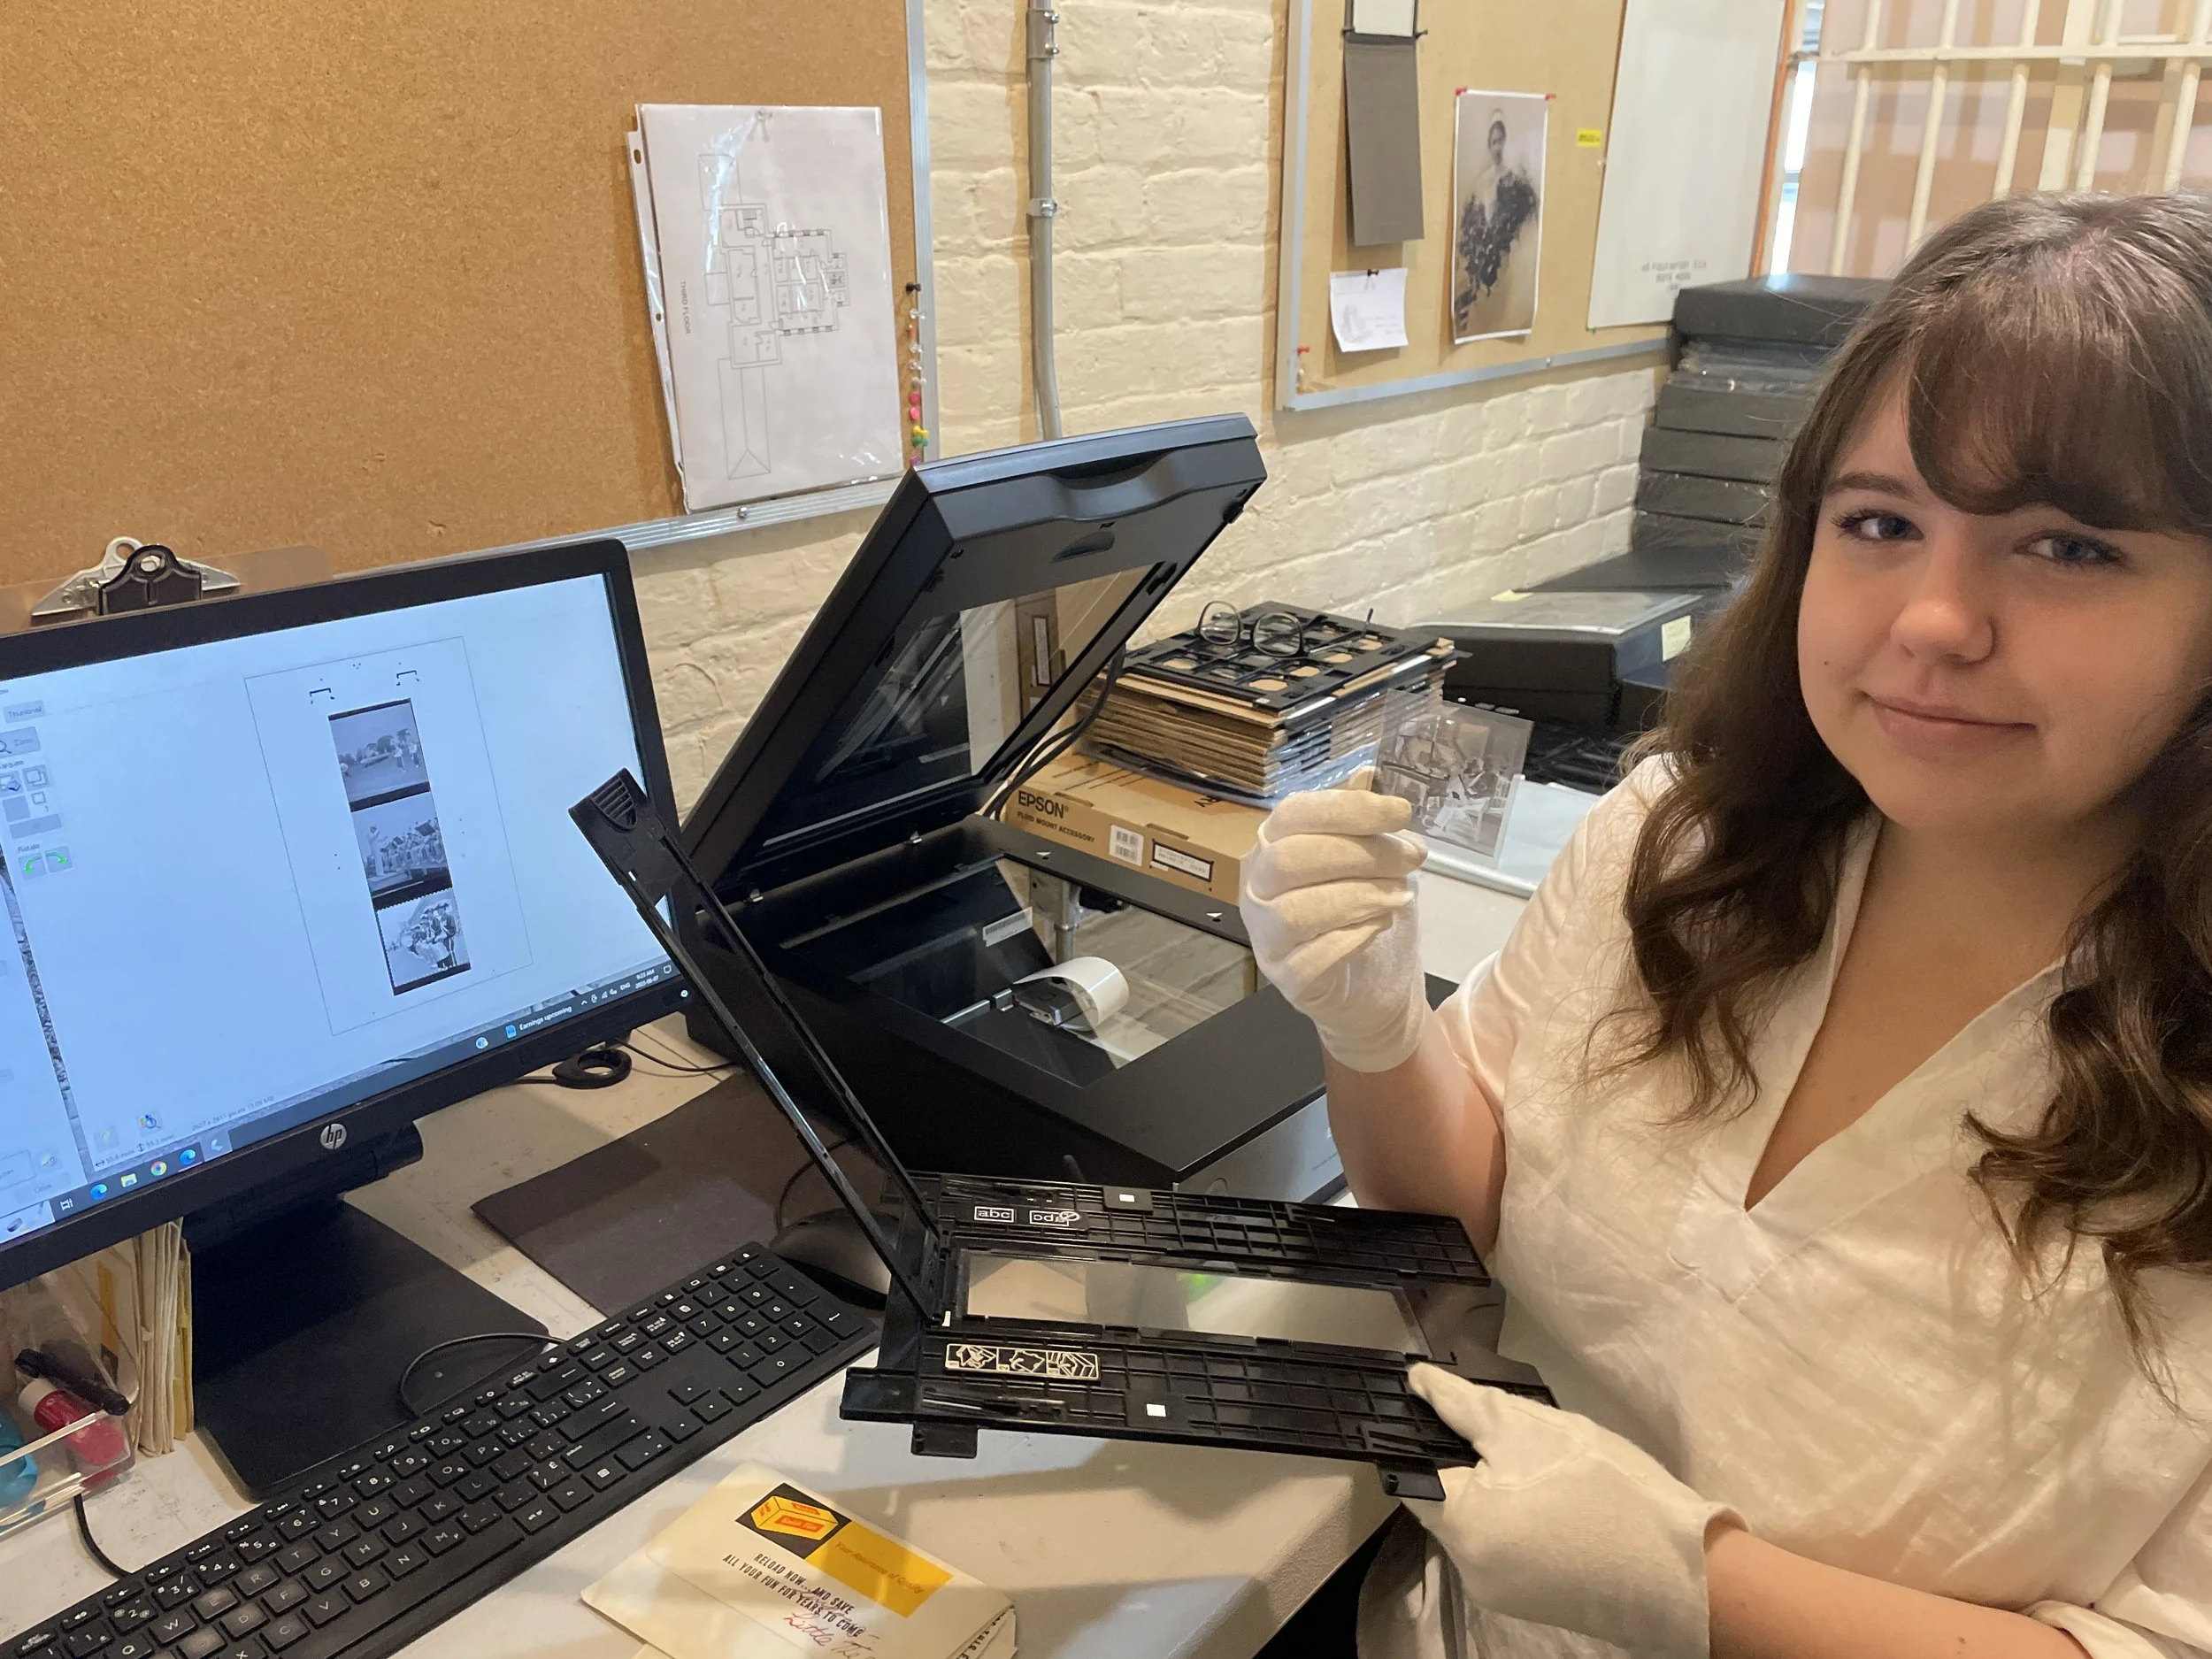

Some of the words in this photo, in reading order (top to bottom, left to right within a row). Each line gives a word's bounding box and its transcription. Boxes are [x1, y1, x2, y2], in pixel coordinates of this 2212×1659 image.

[680, 280, 688, 305] THIRD
[682, 307, 691, 334] FLOOR
[1036, 818, 1057, 831] MOUNT
[1059, 826, 1095, 843] ACCESSORY
[519, 1016, 544, 1031] Earnings
[544, 1006, 572, 1021] upcoming
[326, 1125, 343, 1149] hp
[978, 1209, 1010, 1219] abc
[434, 1502, 446, 1510] K
[368, 1507, 380, 1516] U
[401, 1522, 408, 1531] J
[435, 1532, 449, 1542] M
[253, 1540, 263, 1549] 5
[359, 1544, 371, 1554] H
[398, 1555, 410, 1564] N
[320, 1567, 332, 1576] G
[250, 1574, 263, 1584] R
[359, 1578, 371, 1588] B
[753, 1553, 786, 1574] RELOAD
[830, 1596, 855, 1615] SAVE
[171, 1586, 180, 1594] 3
[279, 1590, 288, 1600] F
[723, 1554, 736, 1567] ALL
[740, 1563, 764, 1579] YOUR
[761, 1575, 780, 1590] FUN
[778, 1585, 797, 1600] FOR
[795, 1594, 824, 1616] YEARS
[823, 1611, 837, 1623] TO
[836, 1618, 864, 1638] COME
[209, 1596, 219, 1607] E
[319, 1601, 329, 1610] V
[238, 1614, 250, 1624] D
[164, 1618, 179, 1631] W
[279, 1625, 291, 1635] C
[122, 1645, 135, 1655] Q
[235, 1650, 249, 1659] X
